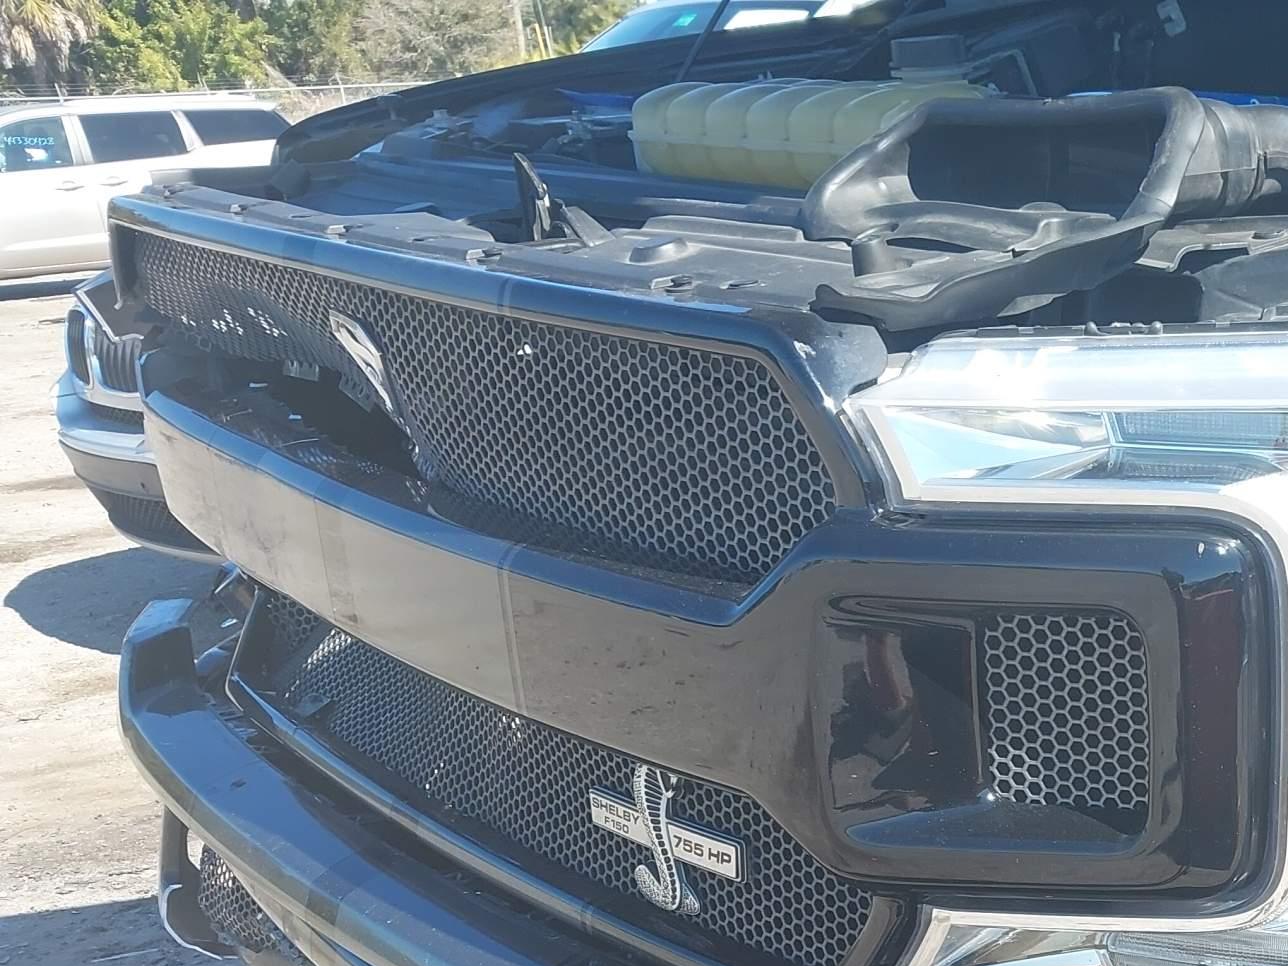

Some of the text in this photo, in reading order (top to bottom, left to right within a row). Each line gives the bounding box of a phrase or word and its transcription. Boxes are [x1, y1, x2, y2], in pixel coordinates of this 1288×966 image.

[592, 797, 640, 825] SHELBY
[604, 816, 630, 835] F150
[673, 835, 732, 865] 755 HP
